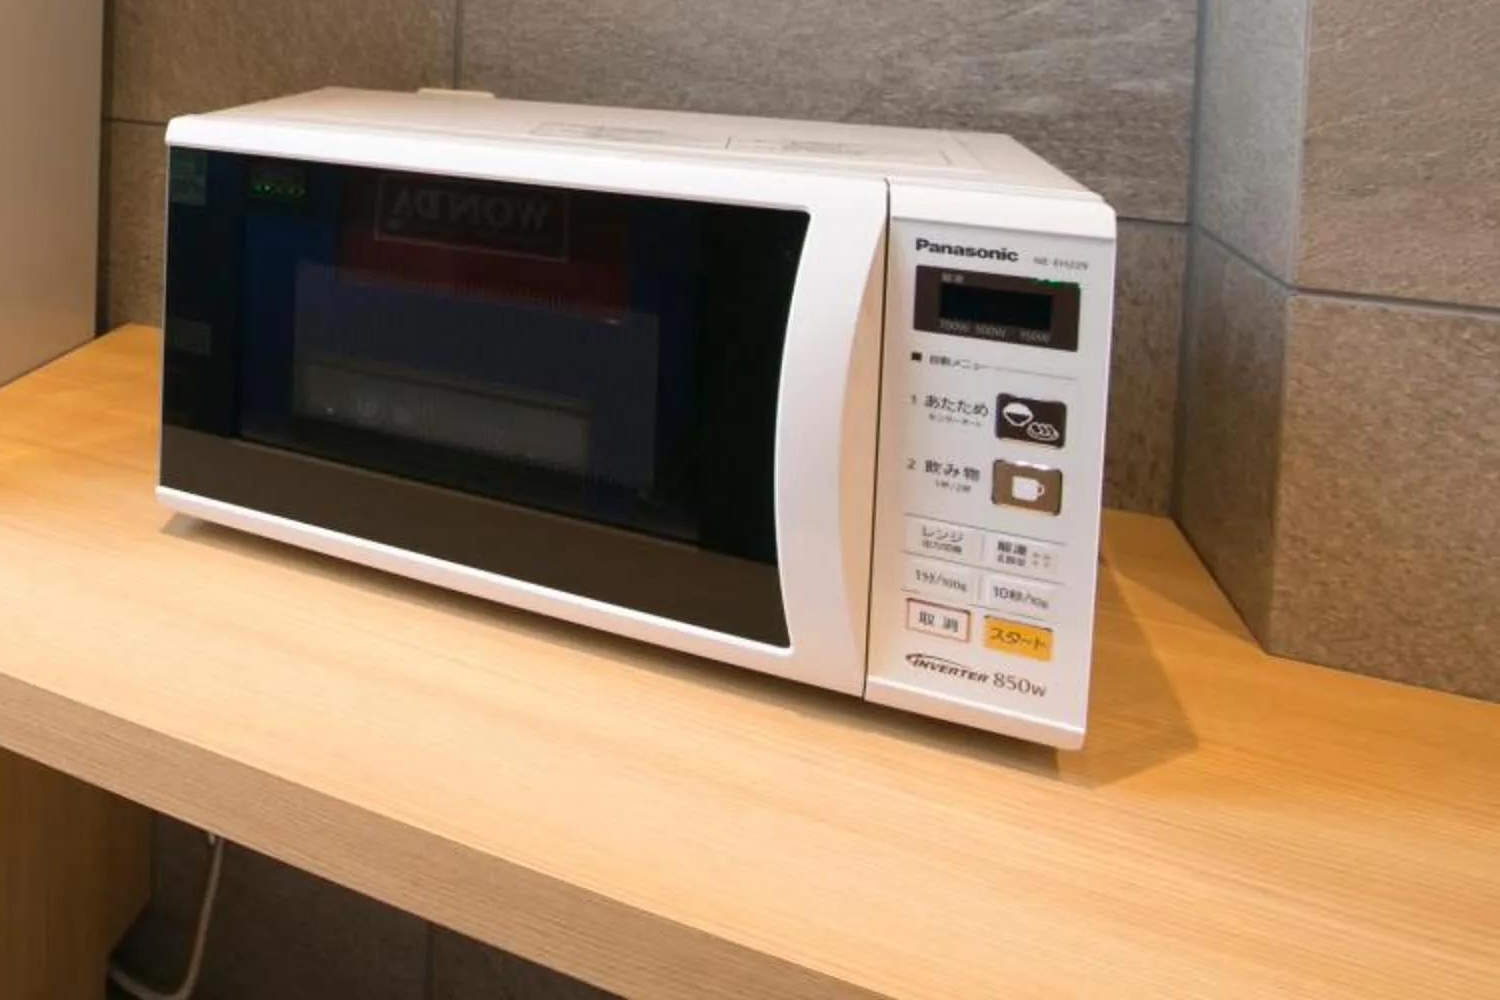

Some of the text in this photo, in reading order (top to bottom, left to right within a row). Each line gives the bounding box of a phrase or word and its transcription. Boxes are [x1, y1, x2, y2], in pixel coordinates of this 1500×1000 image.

[915, 238, 1019, 262] Panasonic
[924, 395, 989, 417] あたため
[925, 460, 980, 482] 飲み物
[922, 525, 963, 543] レンジ
[990, 626, 1046, 651] スタート
[909, 656, 989, 682] INVERTER
